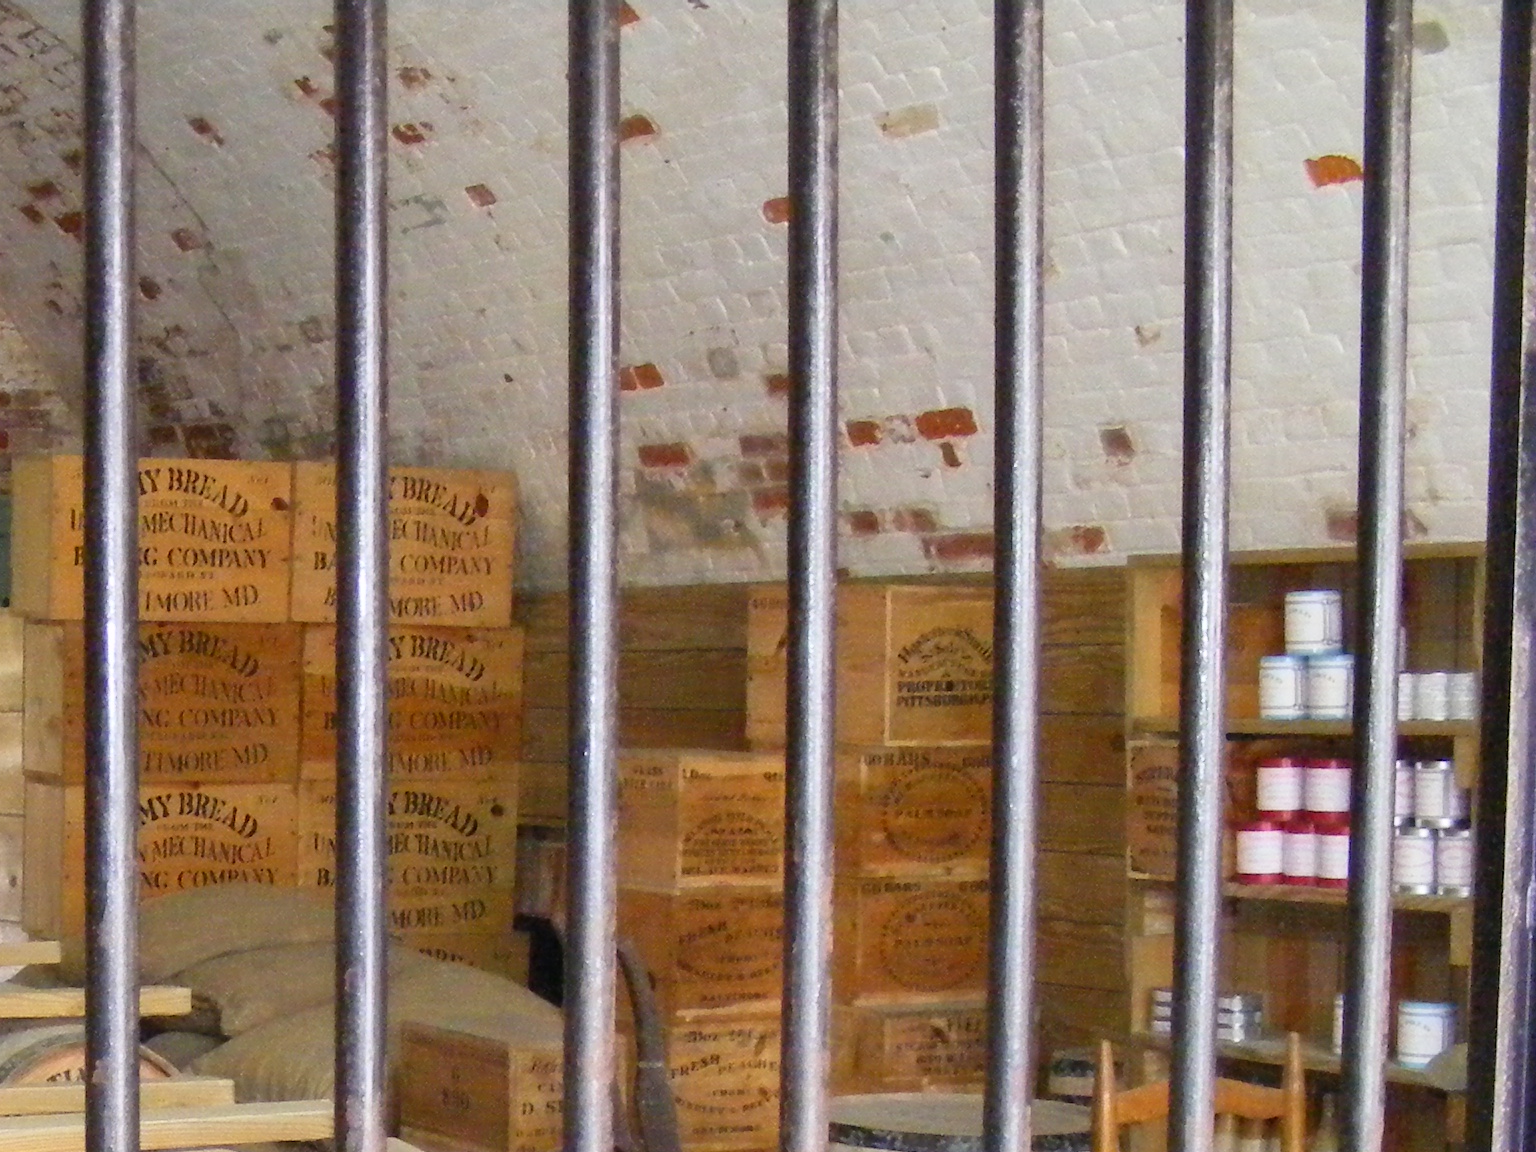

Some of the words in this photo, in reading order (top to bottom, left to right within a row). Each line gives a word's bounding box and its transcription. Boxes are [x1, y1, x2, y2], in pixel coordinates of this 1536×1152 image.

[168, 467, 248, 518] BREAD
[141, 511, 266, 543] MECHANICAL
[392, 518, 490, 551] ECHANICAL
[167, 547, 271, 569] COMPANY
[400, 553, 494, 576] COMPANY
[145, 588, 213, 613] IMORE
[179, 630, 260, 677] BREAD
[410, 635, 485, 681] BREAD
[178, 707, 278, 728] COMPANY
[410, 711, 501, 730] COMPANY
[144, 751, 227, 773] TIMORE
[179, 792, 259, 839] BREAD
[405, 791, 478, 837] BREAD
[152, 835, 275, 865] MECHANICAL
[388, 833, 491, 862] ECHANICAL
[402, 865, 497, 886] COMPANY
